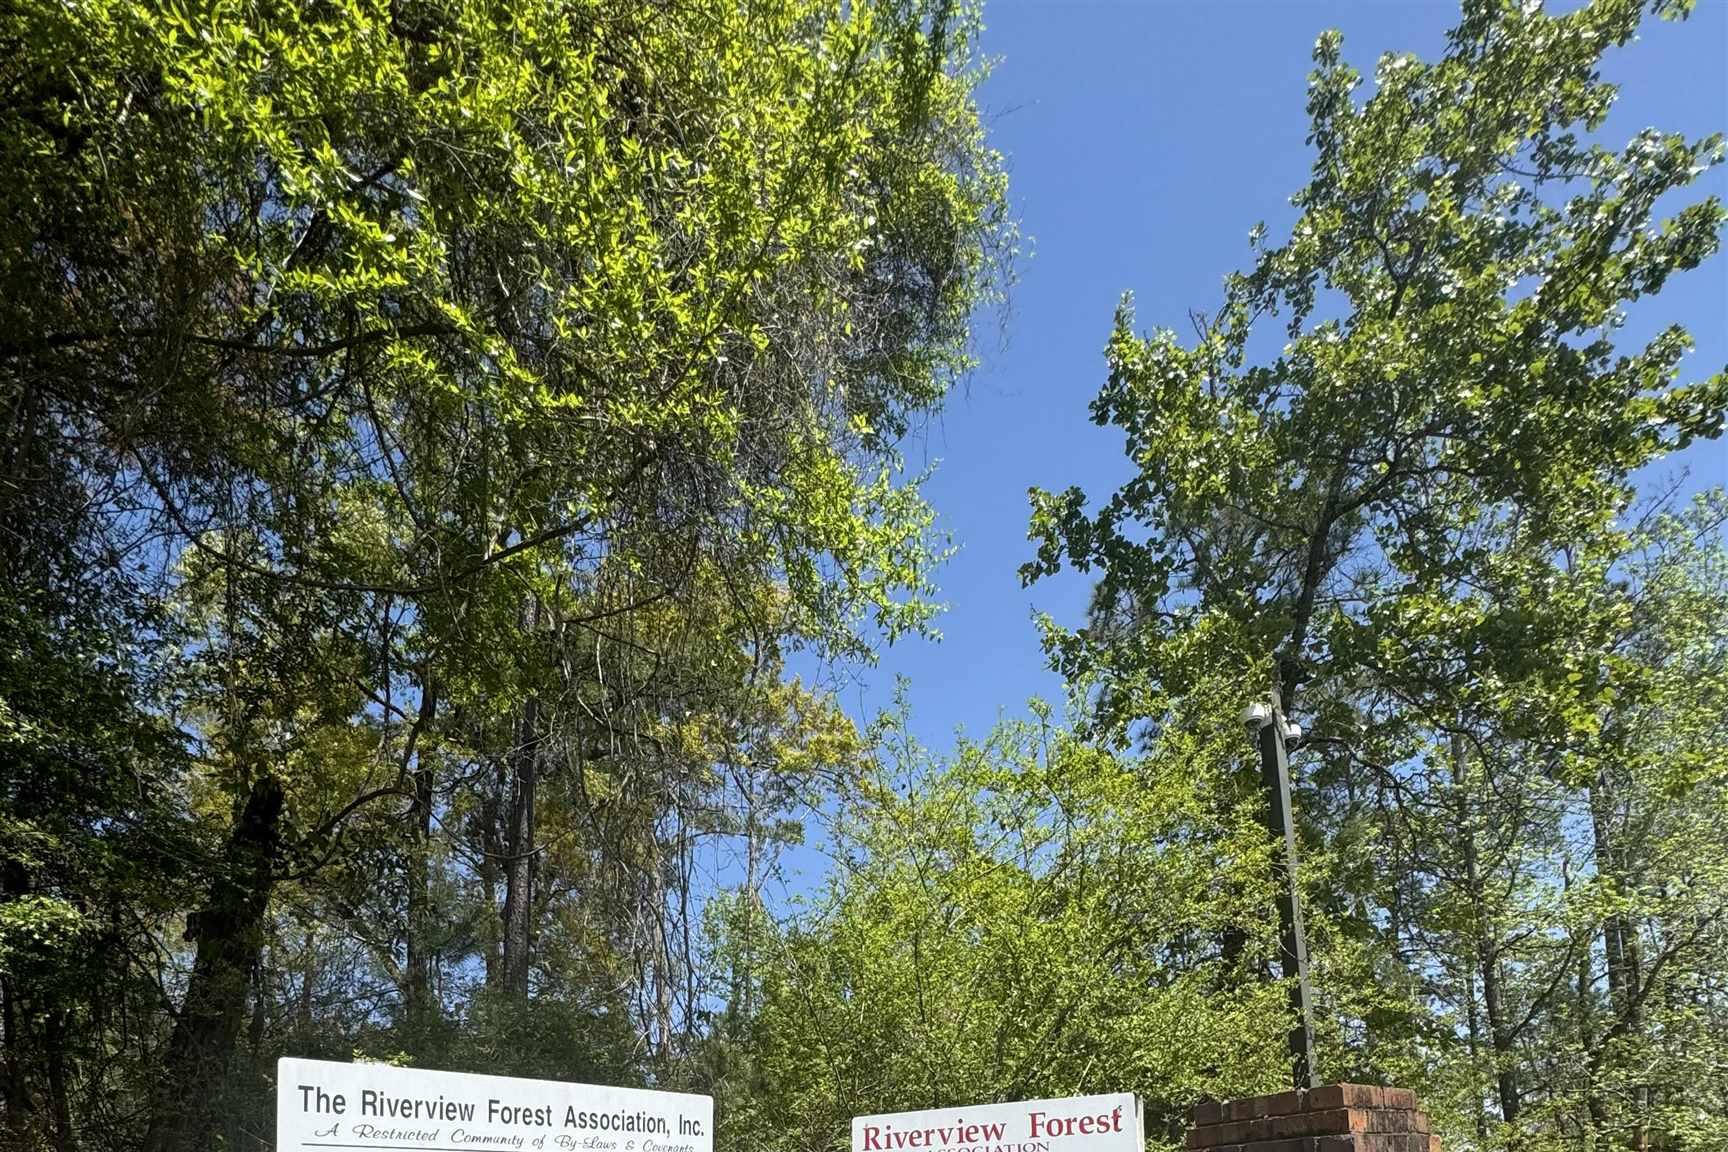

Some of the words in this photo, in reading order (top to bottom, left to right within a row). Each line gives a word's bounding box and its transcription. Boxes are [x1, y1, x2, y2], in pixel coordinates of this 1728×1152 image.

[298, 1085, 346, 1114] The
[362, 1090, 475, 1121] Riverview
[489, 1099, 552, 1127] Forest
[564, 1105, 670, 1137] Association,
[679, 1114, 704, 1136] Inc.
[863, 1118, 1007, 1151] Riverview
[1028, 1106, 1122, 1138] Forest
[315, 1123, 339, 1137] A
[352, 1124, 440, 1141] Restricted
[451, 1129, 524, 1149] Community
[532, 1134, 546, 1150] of
[554, 1135, 616, 1151] By-Laws
[625, 1140, 635, 1150] &
[643, 1139, 694, 1152] Covenants
